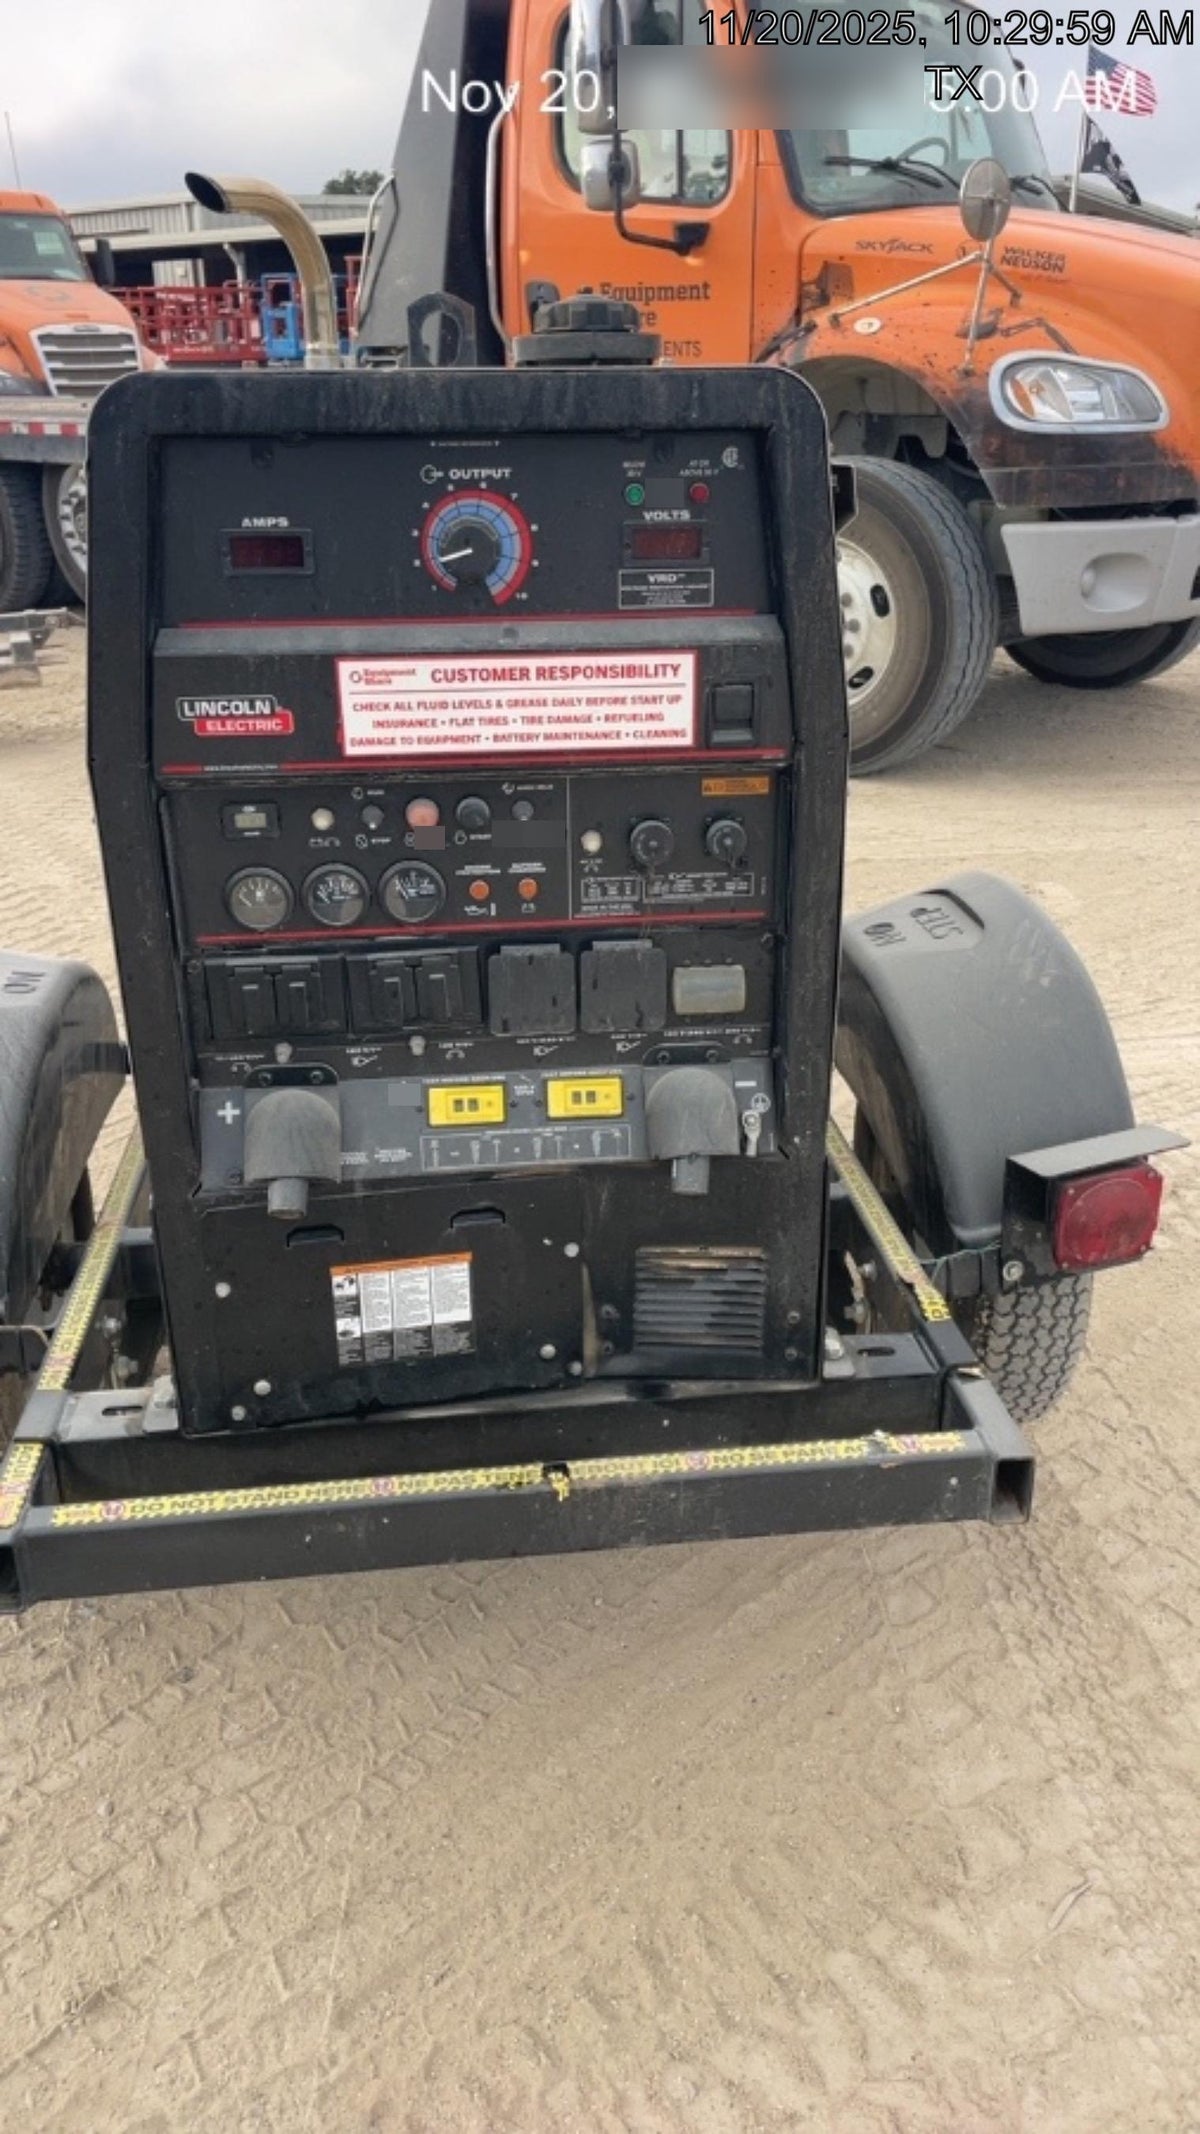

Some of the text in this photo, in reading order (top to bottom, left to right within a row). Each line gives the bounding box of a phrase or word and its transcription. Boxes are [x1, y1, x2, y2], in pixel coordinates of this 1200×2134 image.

[855, 239, 934, 254] SKYJACK
[1000, 256, 1066, 274] NEUSON
[449, 467, 512, 480] OUTPUT
[242, 517, 289, 528] AMPS
[642, 509, 691, 521] VOLTS
[431, 663, 682, 684] CUSTOMER RESPONSIBILITY
[182, 699, 271, 717] LINCOLN
[353, 694, 683, 712] CHECK ALL FLUID LEVELS & GREASE DAILY BEFORE START UP
[205, 717, 283, 732] ELECTRIC
[372, 712, 665, 730] INSURANCE FLAT TIRES TIRE DAMAGE REFUELING
[350, 728, 687, 747] DAMAGE TO EQUIPMENT BATTERY MAINTENANCE CLEANING
[130, 1503, 164, 1514] DO
[169, 1497, 216, 1510] NOT
[225, 1490, 300, 1505] STAND
[305, 1484, 366, 1498] HERE
[713, 1452, 745, 1464] NO
